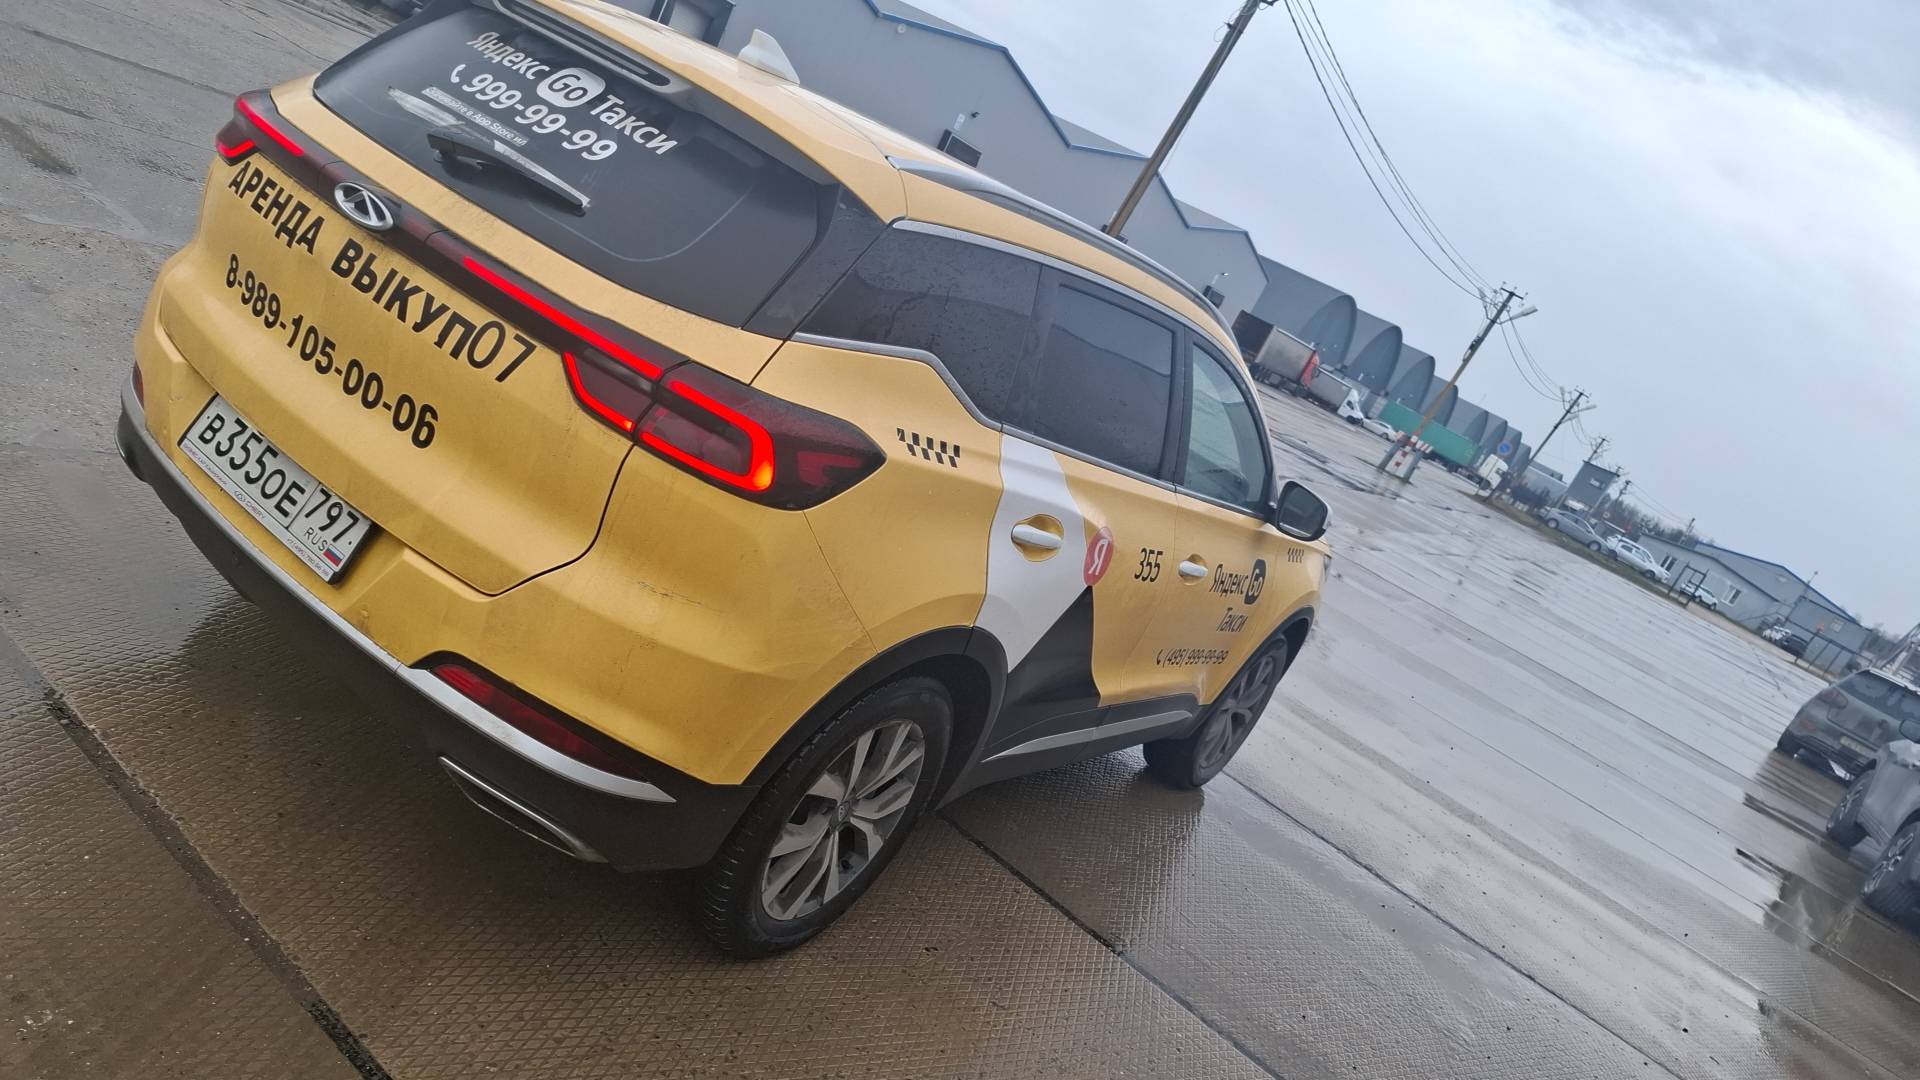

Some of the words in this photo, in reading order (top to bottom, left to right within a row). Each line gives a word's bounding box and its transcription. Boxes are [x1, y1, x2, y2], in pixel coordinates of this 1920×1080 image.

[466, 31, 550, 80] Яндекс
[547, 73, 588, 102] Go
[589, 94, 678, 155] Такси
[461, 73, 618, 161] 999-99-99
[473, 113, 492, 129] App
[490, 122, 514, 139] Store
[228, 161, 326, 255] АРЕНДА
[225, 253, 440, 450] 8-989-105-00-06
[198, 413, 306, 518] В355ОЕ
[304, 487, 361, 544] 797
[304, 527, 328, 552] RUS
[1088, 538, 1109, 576] Я
[1134, 547, 1164, 583] 355
[1209, 564, 1249, 597] Яндекс
[1248, 568, 1263, 597] Go
[1216, 607, 1249, 633] Такси
[1163, 648, 1189, 668] (495)
